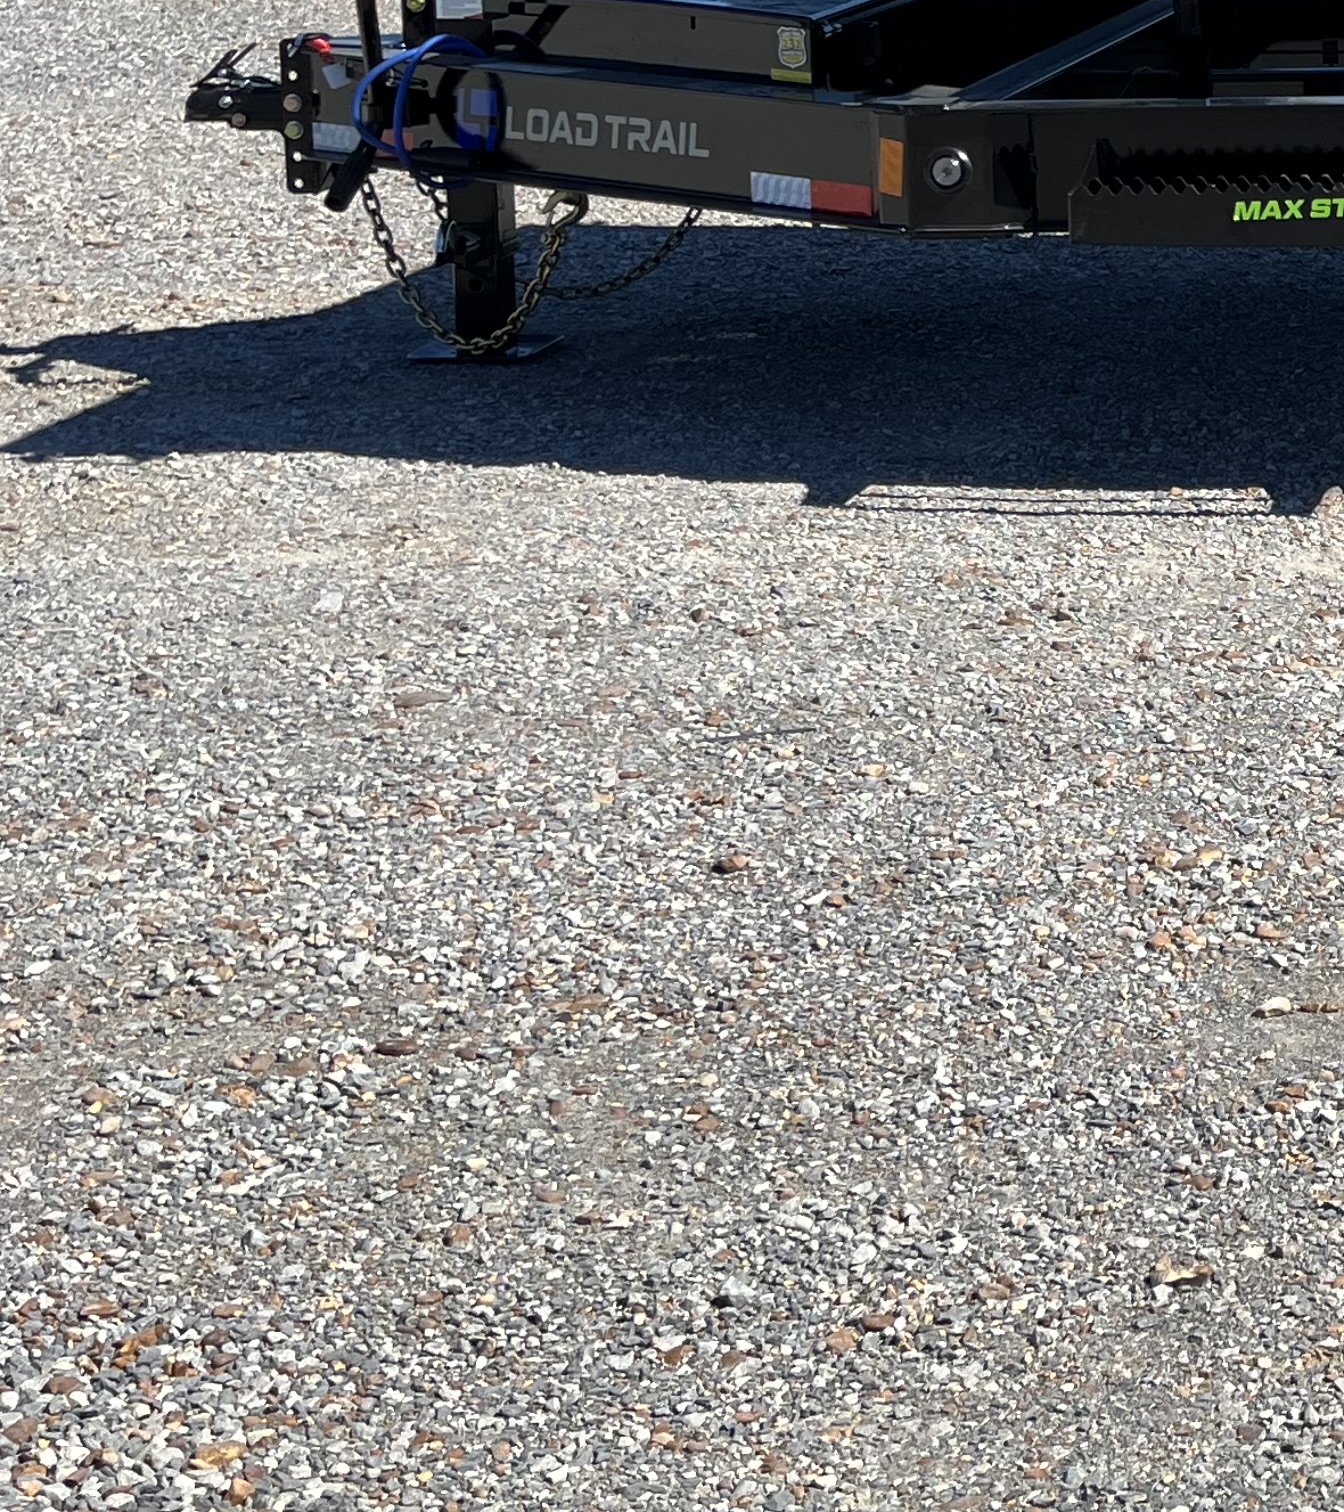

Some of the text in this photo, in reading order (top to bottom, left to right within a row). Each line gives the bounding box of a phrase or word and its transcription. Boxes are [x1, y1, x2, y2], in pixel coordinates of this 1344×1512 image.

[505, 106, 710, 158] LOAD TRAIL
[1234, 198, 1305, 221] MAX
